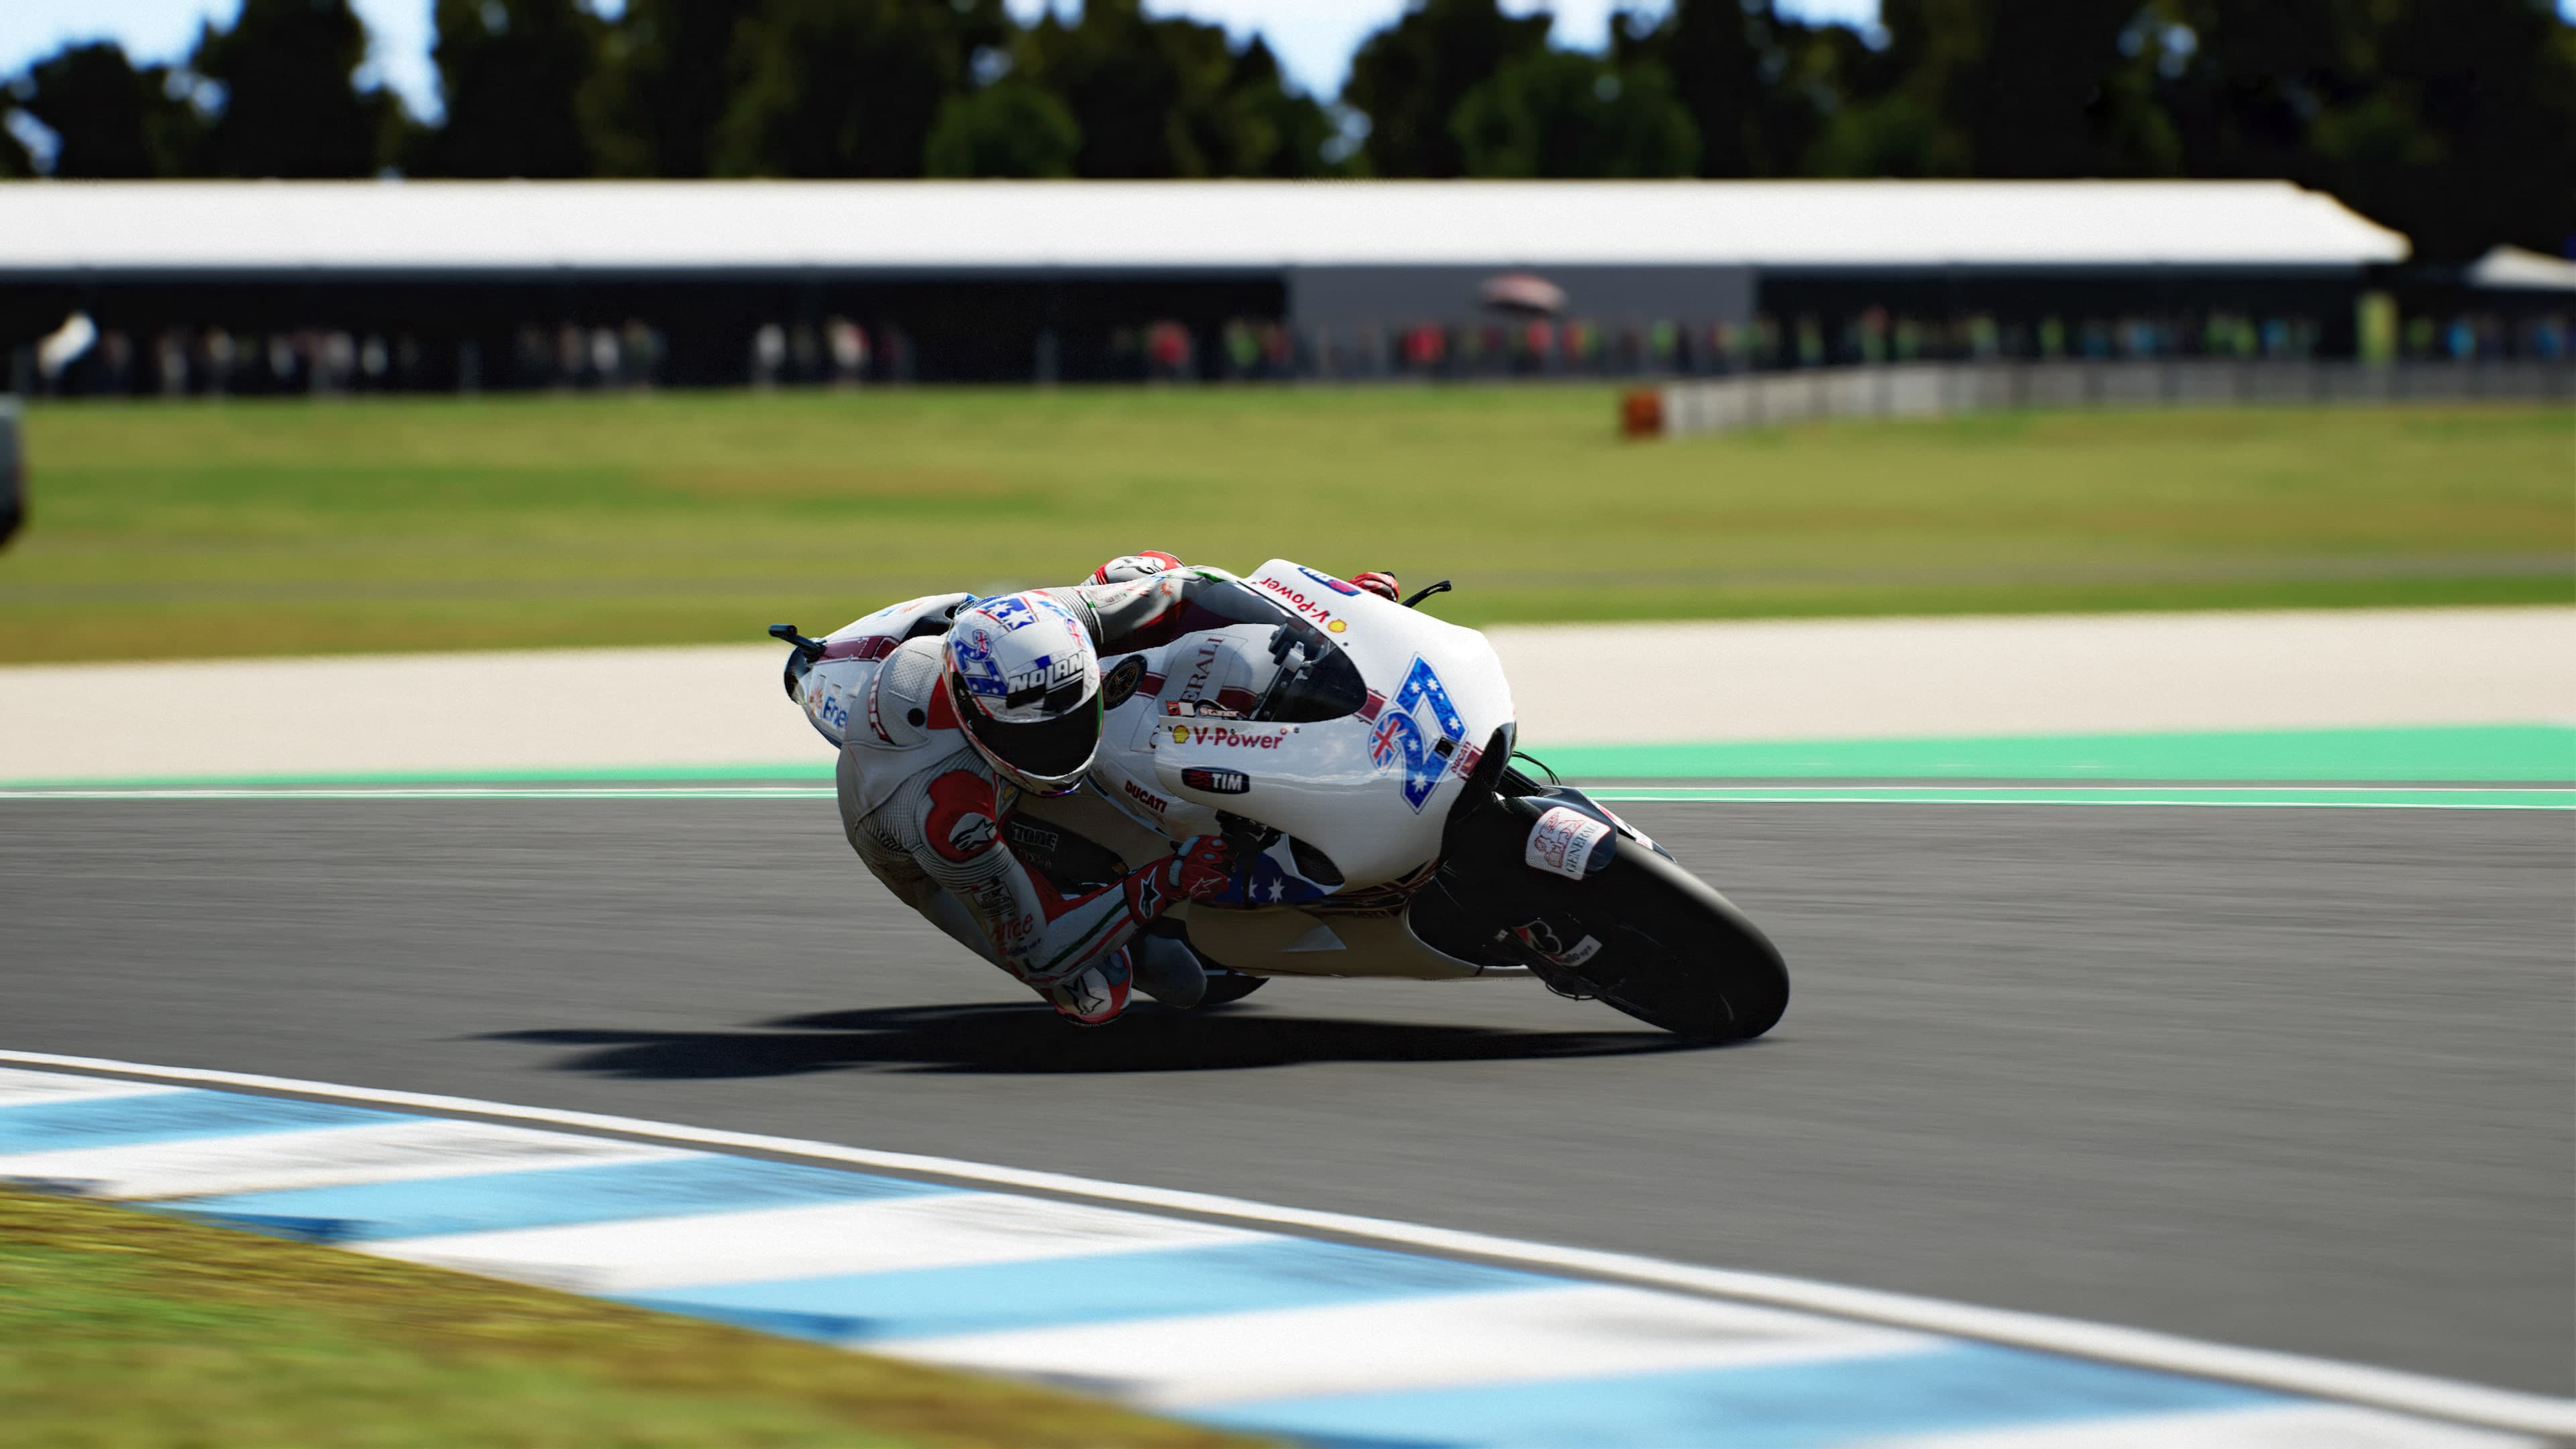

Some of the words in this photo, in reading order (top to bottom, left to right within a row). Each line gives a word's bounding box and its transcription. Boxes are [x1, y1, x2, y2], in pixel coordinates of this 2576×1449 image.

[1007, 651, 1084, 694] NOLAN
[1193, 726, 1284, 750] V-Power
[1368, 651, 1470, 815] 27
[1450, 741, 1472, 773] DUCATI
[1124, 780, 1168, 814] DUCATI
[1212, 773, 1242, 792] TIM
